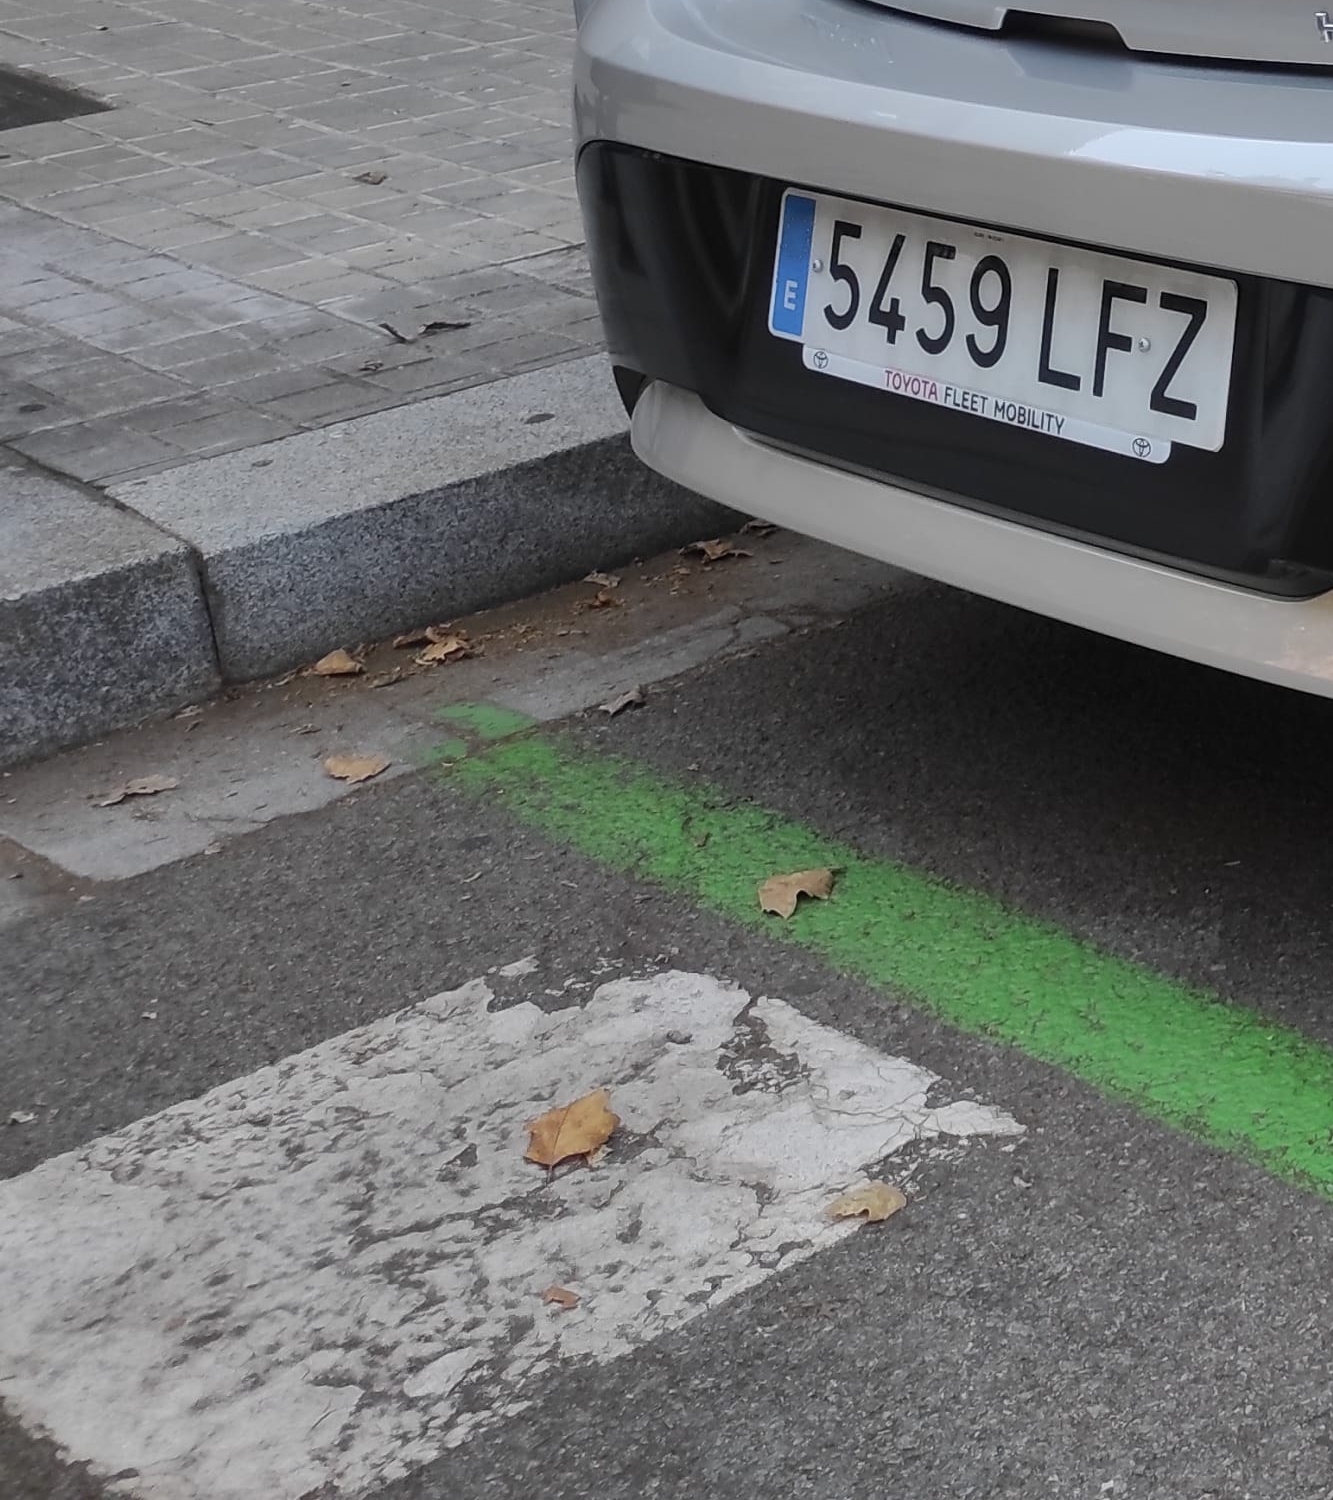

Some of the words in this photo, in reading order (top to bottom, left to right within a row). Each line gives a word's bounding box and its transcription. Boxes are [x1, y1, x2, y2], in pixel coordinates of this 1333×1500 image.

[783, 279, 799, 311] E
[823, 219, 1012, 369] 5459
[1038, 267, 1208, 421] LFZ
[884, 369, 938, 401] TOYOTA
[944, 386, 989, 415] FLEET
[994, 399, 1066, 436] MOBILITY
